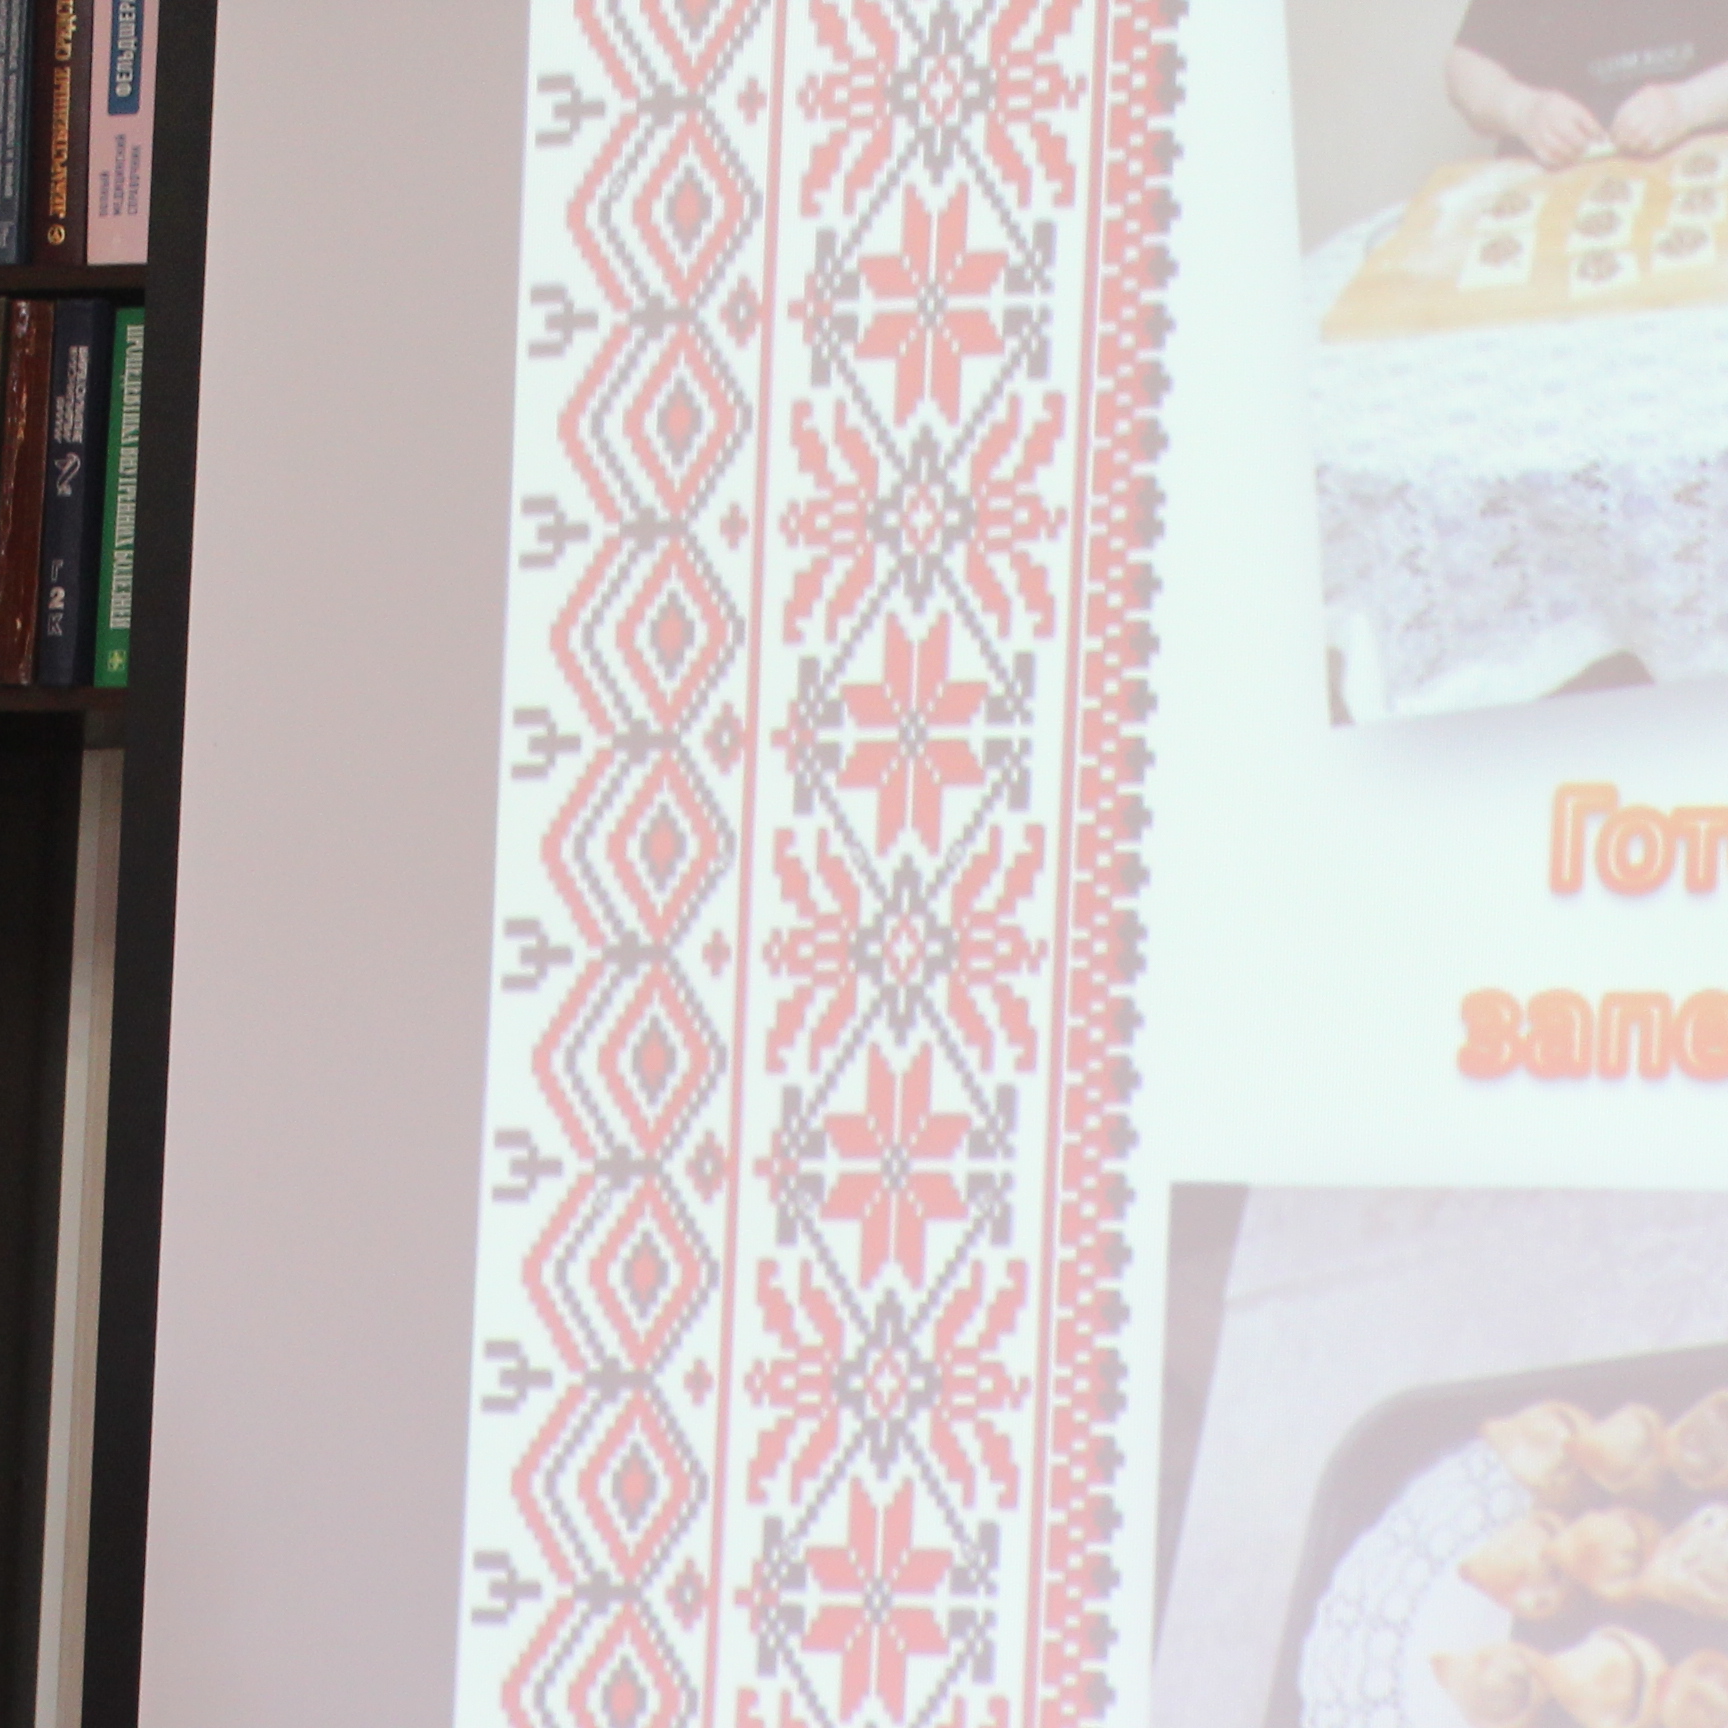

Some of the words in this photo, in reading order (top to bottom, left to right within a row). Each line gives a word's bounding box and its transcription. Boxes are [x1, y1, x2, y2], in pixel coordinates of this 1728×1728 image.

[48, 67, 71, 218] ЛЕКАРСТВЕННЫЕ
[120, 324, 145, 443] ПРОПЕДЕВТИКА
[114, 447, 139, 548] ВНУТРЕННИХ
